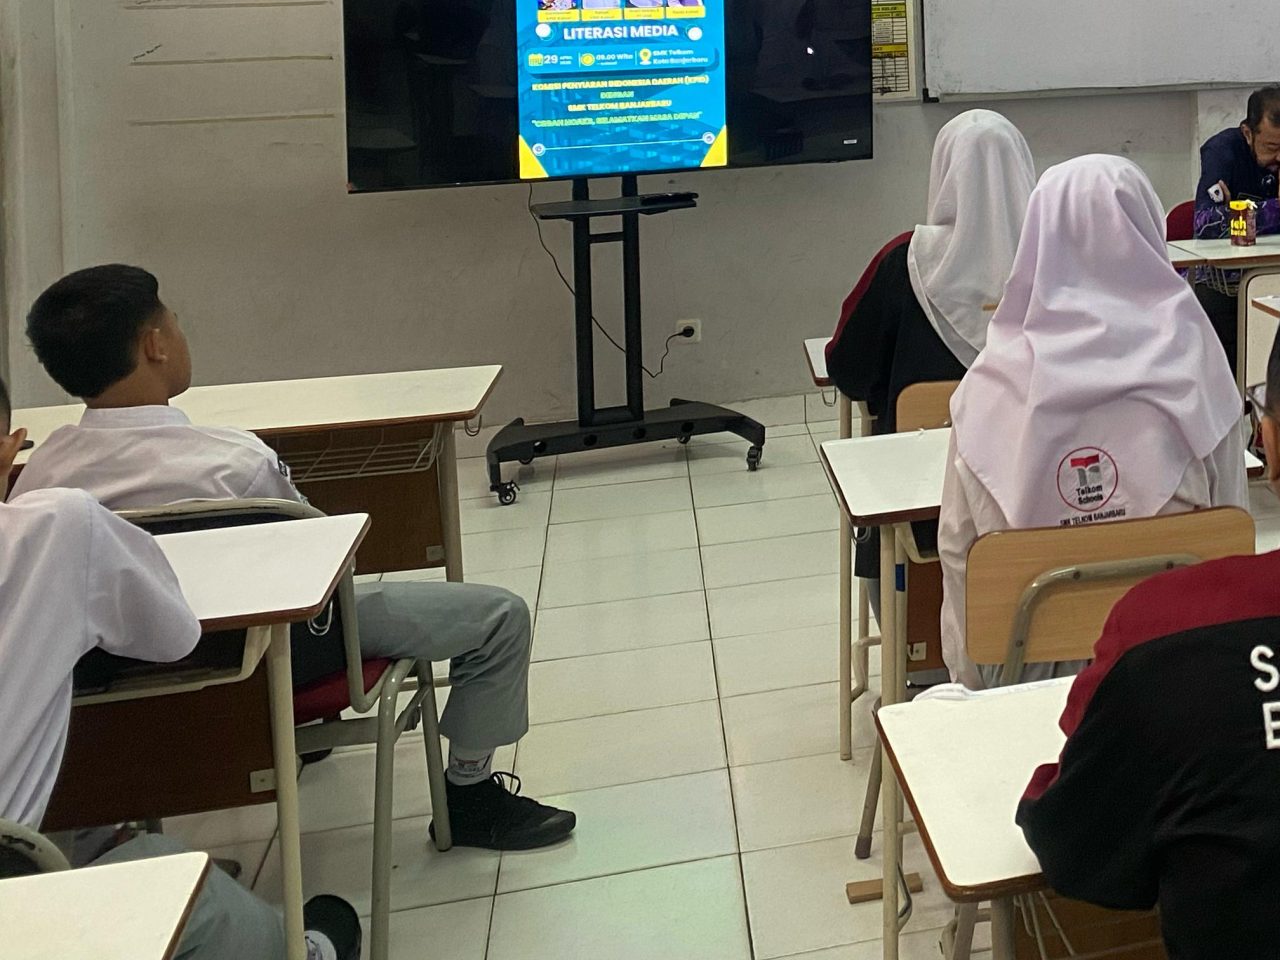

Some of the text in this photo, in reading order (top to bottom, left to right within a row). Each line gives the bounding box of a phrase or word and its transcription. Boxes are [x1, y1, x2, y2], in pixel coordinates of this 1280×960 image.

[563, 24, 679, 41] LITERASI MEDIA
[543, 53, 558, 65] 29
[531, 82, 562, 91] KOMISI
[562, 81, 607, 90] PENYIARAN
[608, 79, 651, 88] INDONESIA
[652, 77, 684, 86] DAERAH
[587, 102, 617, 111] TELKOM
[1230, 215, 1247, 230] teh
[1076, 485, 1103, 496] Telkom
[1078, 494, 1104, 505] Schools
[1072, 514, 1093, 525] TELKOM
[1093, 508, 1126, 522] BANJARBARU
